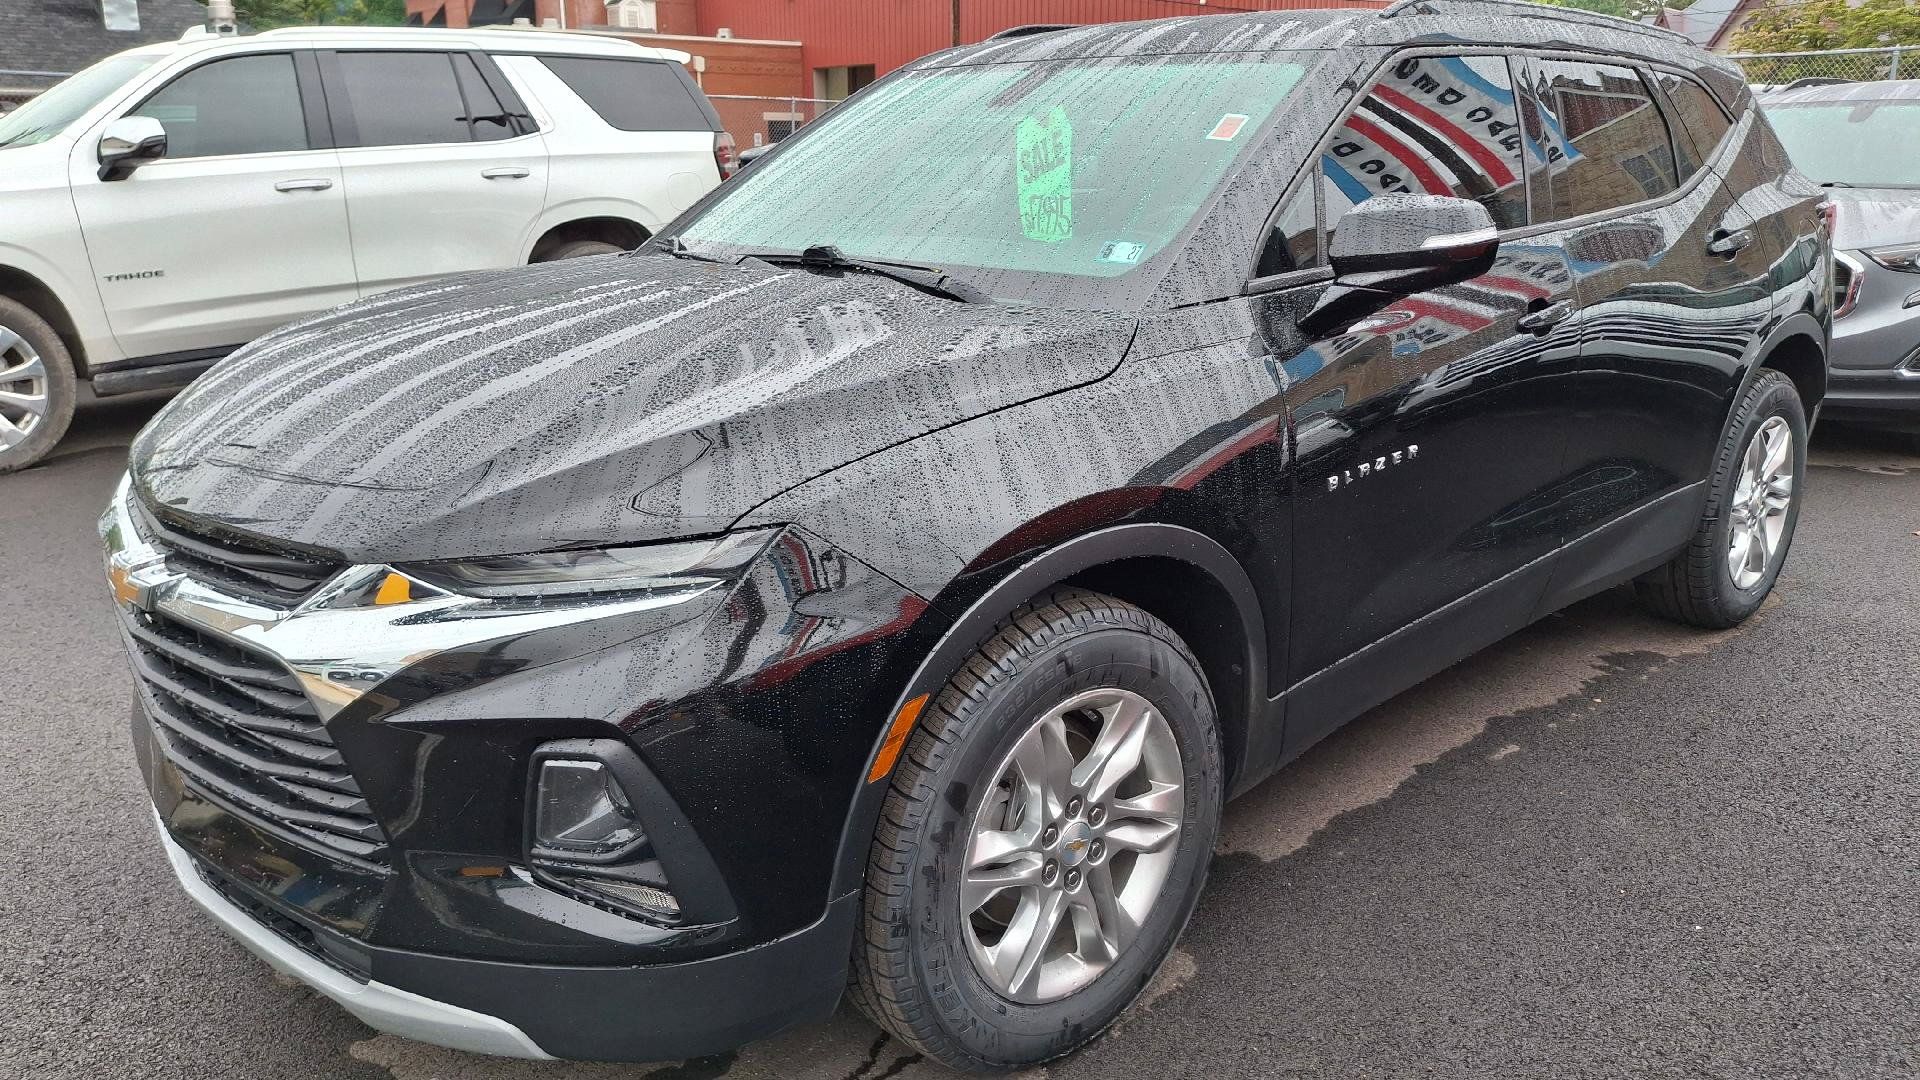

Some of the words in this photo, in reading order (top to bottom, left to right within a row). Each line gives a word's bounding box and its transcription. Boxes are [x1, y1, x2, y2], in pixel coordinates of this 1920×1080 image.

[1020, 130, 1066, 184] SALE
[103, 270, 164, 282] TAHOE
[1327, 444, 1419, 492] BLAZER
